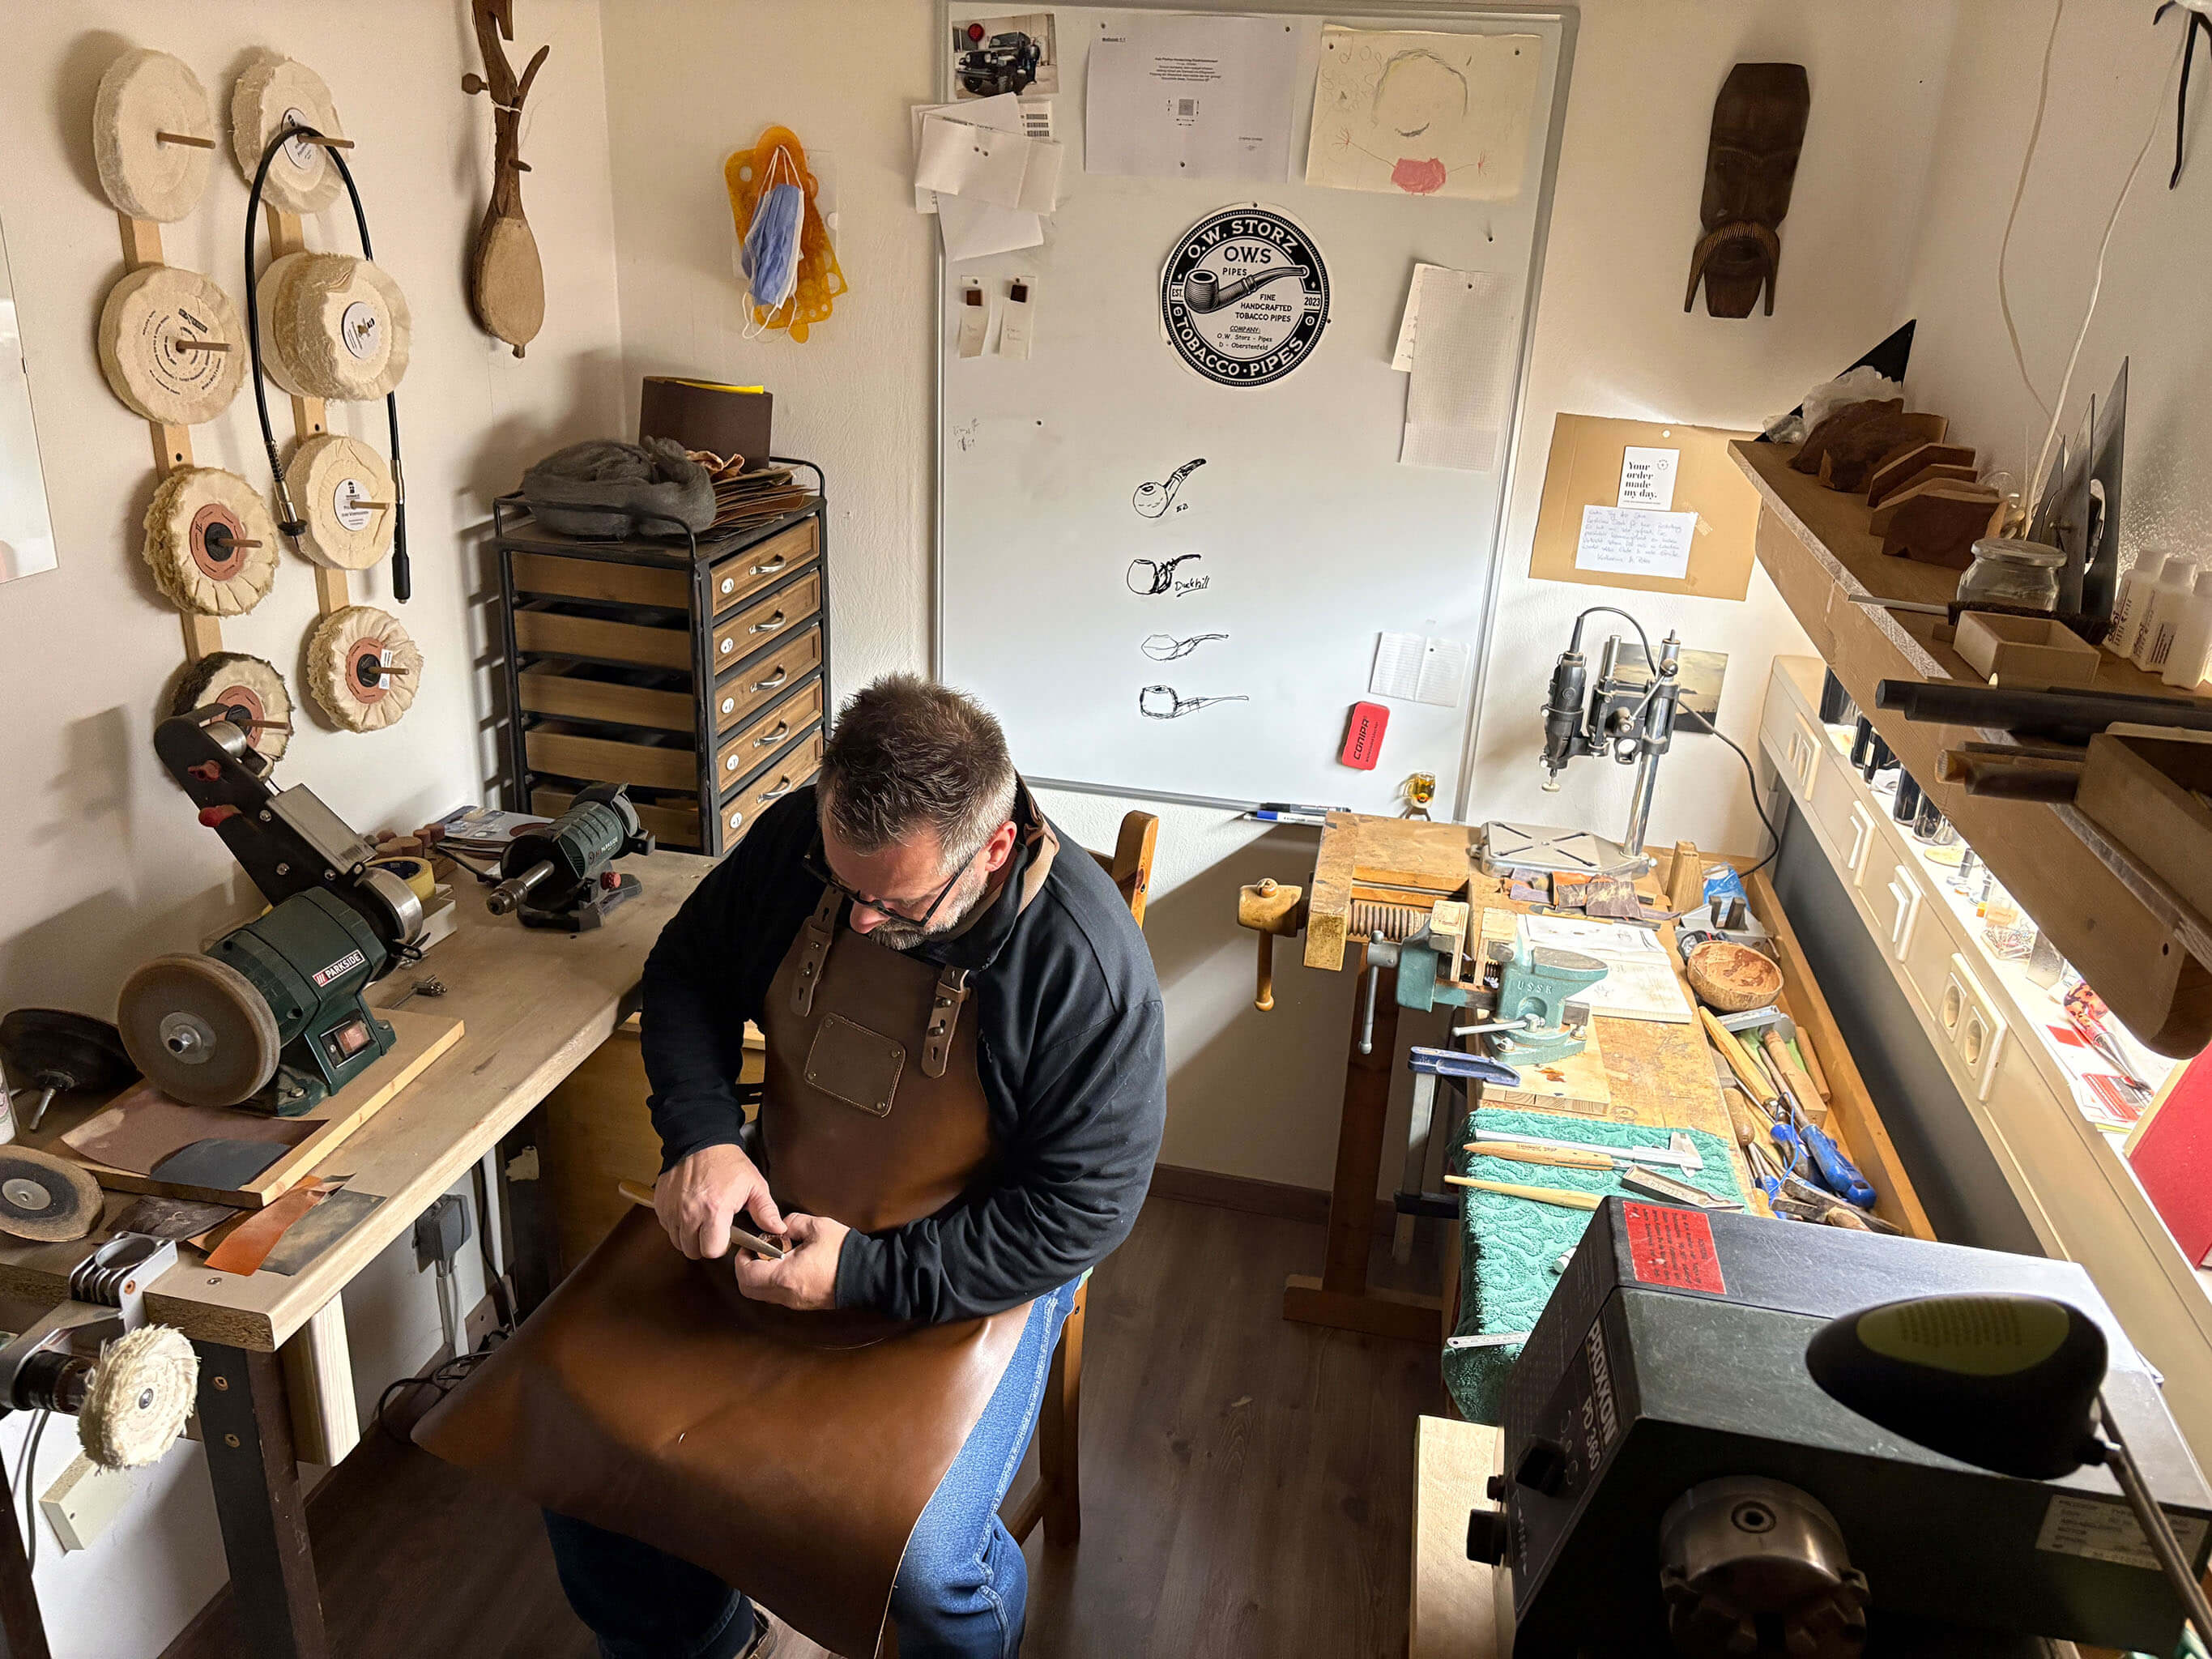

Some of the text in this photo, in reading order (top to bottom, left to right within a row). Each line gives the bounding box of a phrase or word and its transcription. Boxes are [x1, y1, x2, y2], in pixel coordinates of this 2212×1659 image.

[1231, 219, 1298, 254] STORZ
[1224, 245, 1272, 264] O.W.S
[1222, 267, 1248, 276] PIPES
[1171, 288, 1183, 298] EST.
[1259, 293, 1276, 301] FINE
[1240, 302, 1293, 312] HANDCRAFTED
[1304, 296, 1320, 307] 2023
[1235, 311, 1292, 322] TOBACCO PIPES
[1257, 335, 1273, 343] Pipes
[1175, 316, 1303, 377] TOBACCO PIPES
[1231, 342, 1268, 351] Oberstenfeld
[1628, 461, 1652, 471] Your
[1626, 471, 1655, 480] order
[1626, 480, 1652, 489] made
[1624, 488, 1658, 500] my day.
[325, 953, 361, 979] PARKSIDE
[1517, 980, 1554, 995] USSR
[1587, 1317, 1619, 1446] PROXXON
[1582, 1395, 1601, 1472] PD 360
